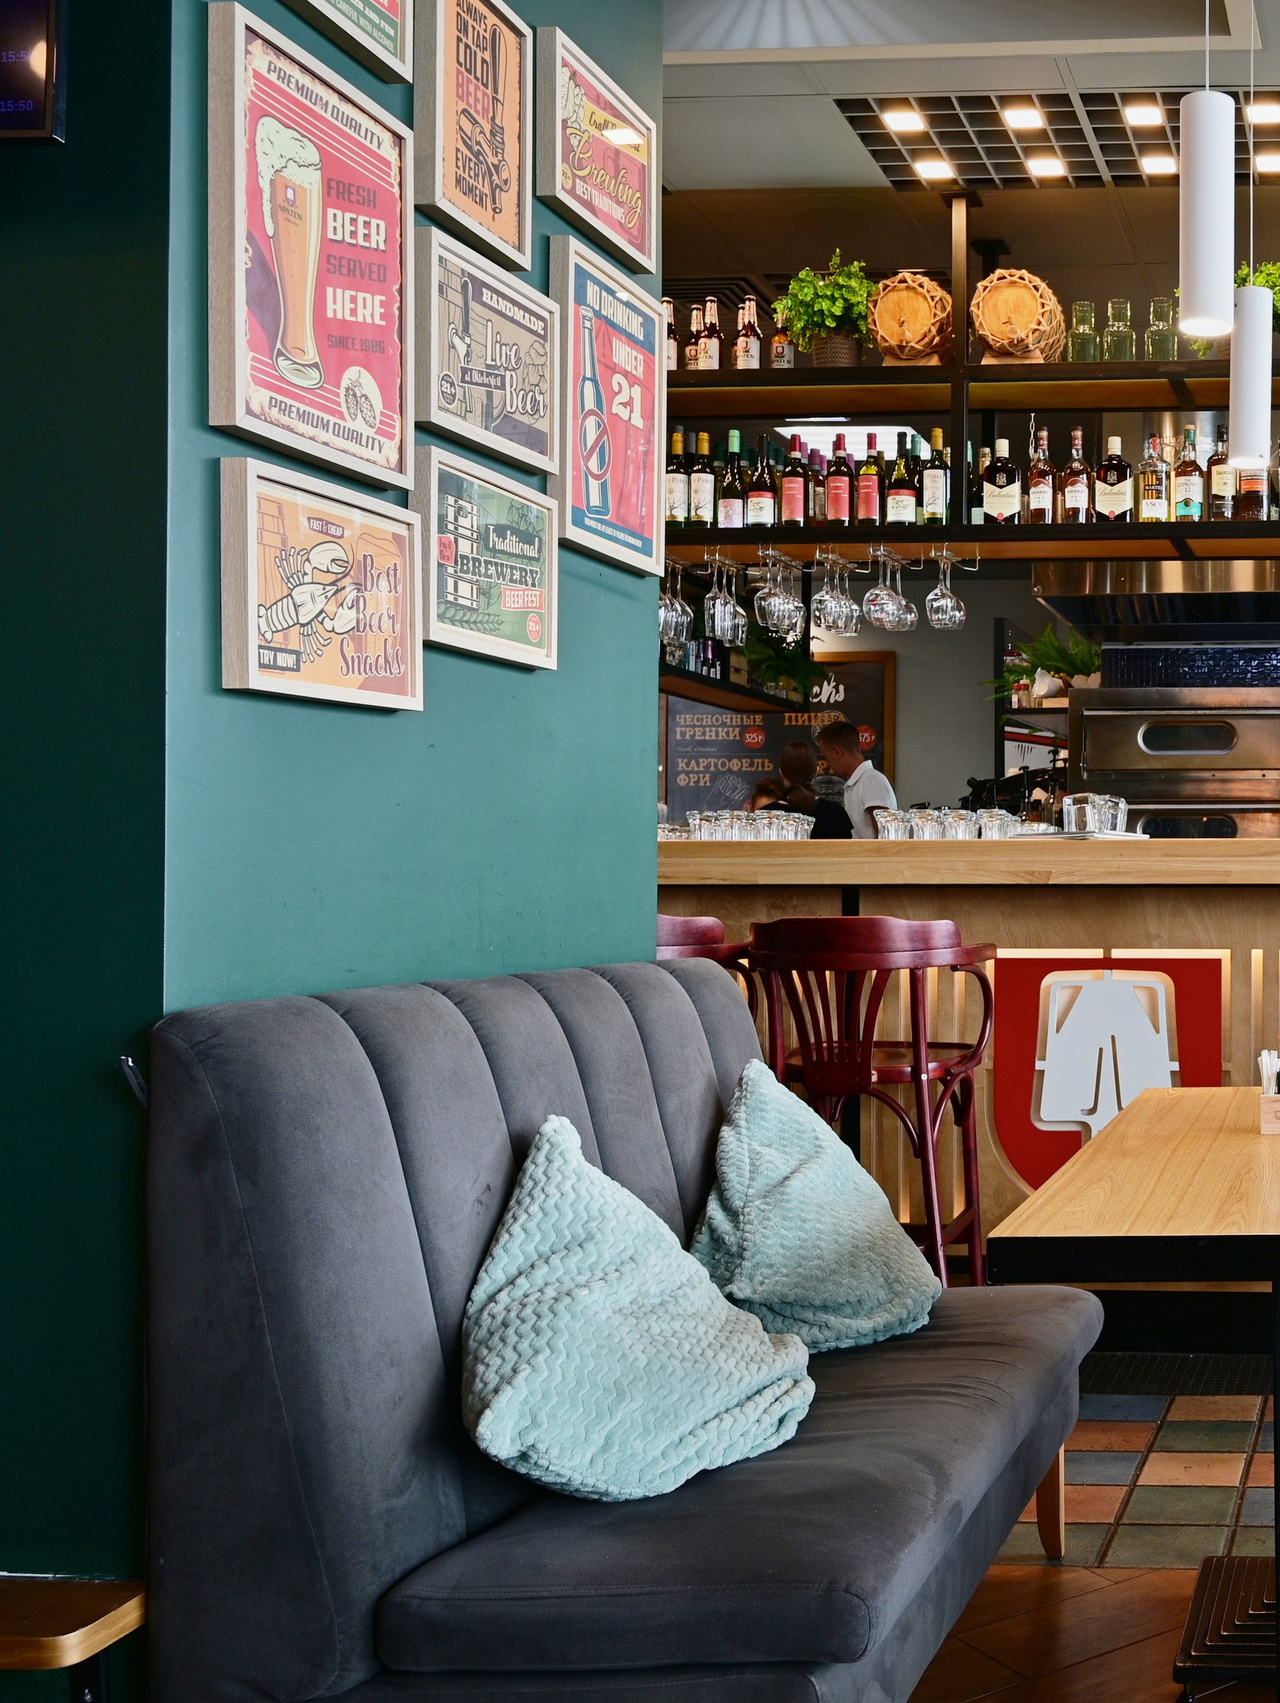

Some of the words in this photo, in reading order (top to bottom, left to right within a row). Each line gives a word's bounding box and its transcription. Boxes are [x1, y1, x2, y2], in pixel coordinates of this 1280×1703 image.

[365, 6, 379, 24] AND
[456, 11, 469, 41] ON
[471, 24, 488, 54] TAP
[456, 35, 490, 90] COLD
[267, 60, 329, 114] PREMIUM
[331, 105, 384, 150] QUALITY
[456, 65, 491, 125] BEER
[455, 146, 488, 189] EVERY
[566, 126, 642, 229] Brewing
[327, 177, 378, 209] FRESH
[455, 170, 489, 212] MOMENT
[576, 179, 591, 201] BEST
[592, 189, 625, 223] TRADITIONS
[278, 203, 303, 221] SPATEN
[327, 207, 387, 252] BEER
[327, 254, 387, 283] SERVED
[327, 286, 387, 325] HERE
[482, 287, 545, 336] HANDMADE
[586, 279, 600, 311] NO
[601, 289, 644, 341] DRINKING
[327, 334, 357, 350] SINCE
[360, 338, 385, 354] 1986
[485, 319, 522, 369] Live
[612, 337, 644, 379] UNDER
[441, 381, 456, 395] 21+
[505, 370, 548, 418] Beer
[611, 373, 644, 430] 21
[268, 396, 330, 433] PREMIUM
[332, 421, 385, 454] QUALITY
[310, 518, 322, 531] FAST
[328, 523, 343, 537] CHEAP
[488, 525, 540, 558] Traditional
[362, 554, 402, 595] Best
[459, 553, 539, 588] BREWERY
[355, 592, 399, 635] Beer
[506, 589, 524, 607] BEER
[525, 590, 541, 608] FEST
[528, 621, 539, 631] 21+
[259, 649, 274, 665] TRY
[277, 653, 297, 669] NOW!
[340, 636, 405, 677] Snacks
[676, 714, 763, 726] ЧЕСНОЧНЫЕ
[676, 727, 741, 740] ГРЕНКИ
[745, 733, 758, 743] 325
[676, 774, 711, 787] ФРИ
[677, 758, 774, 771] КАРТОФЕЛЬ
